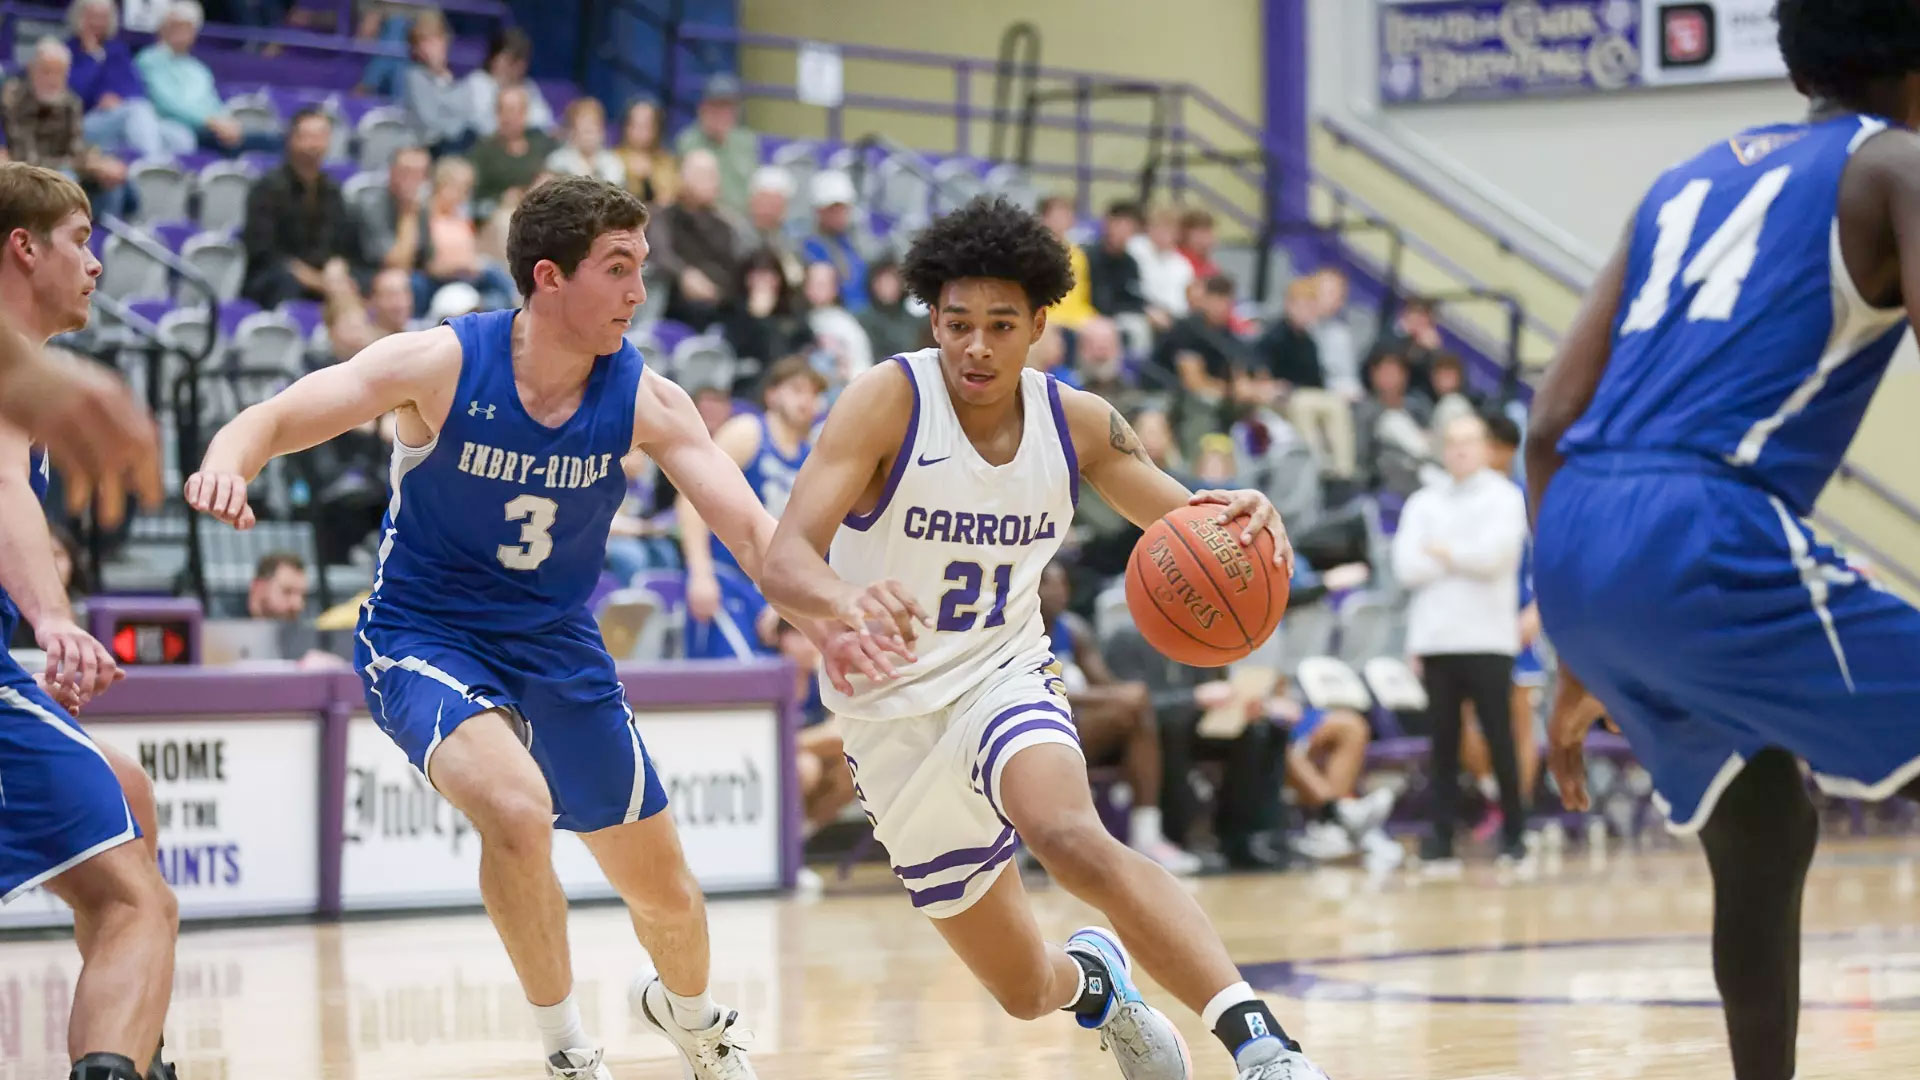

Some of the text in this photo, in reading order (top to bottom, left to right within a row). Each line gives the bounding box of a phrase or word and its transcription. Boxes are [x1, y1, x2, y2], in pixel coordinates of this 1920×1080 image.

[1620, 163, 1792, 336] 14
[496, 493, 559, 571] 3
[904, 506, 1055, 546] CARROLL
[1186, 518, 1249, 596] LEGACY
[935, 559, 1016, 632] 21
[1147, 534, 1225, 631] SPALDING
[138, 737, 227, 781] HOME
[182, 800, 216, 828] THE
[157, 843, 240, 886] AINTS
